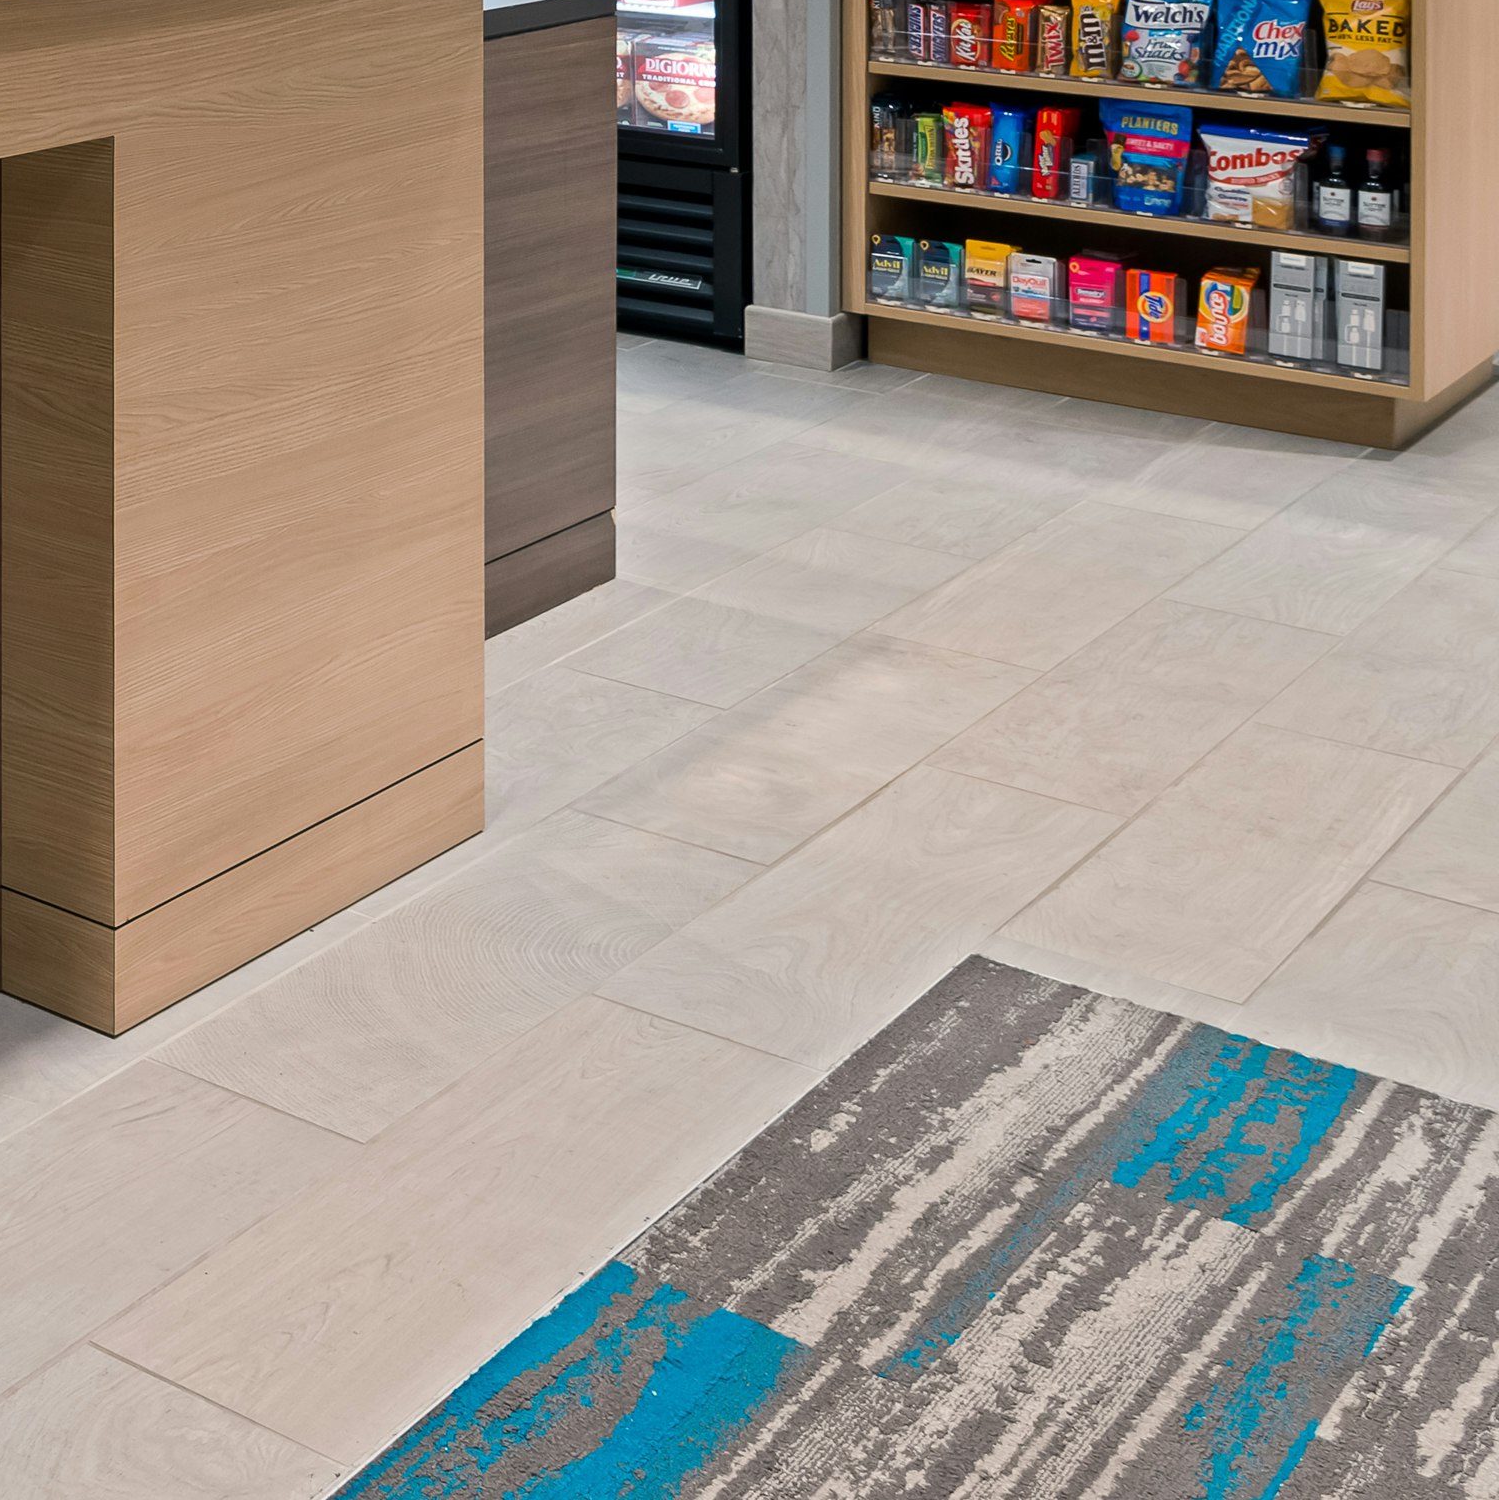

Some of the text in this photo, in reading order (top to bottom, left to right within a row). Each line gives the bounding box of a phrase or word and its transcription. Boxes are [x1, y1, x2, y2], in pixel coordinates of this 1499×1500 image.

[1132, 3, 1204, 24] Welch's
[1254, 21, 1305, 40] Chex
[1327, 18, 1405, 37] BAKED
[1044, 21, 1064, 70] TWIX
[1255, 39, 1301, 60] mix
[642, 74, 697, 85] TRADITIONAL
[1121, 116, 1179, 136] PLANTERS
[873, 259, 901, 269] Advil
[923, 265, 949, 276] Advil
[1012, 275, 1047, 287] DayQuil
[1144, 294, 1165, 320] Tide
